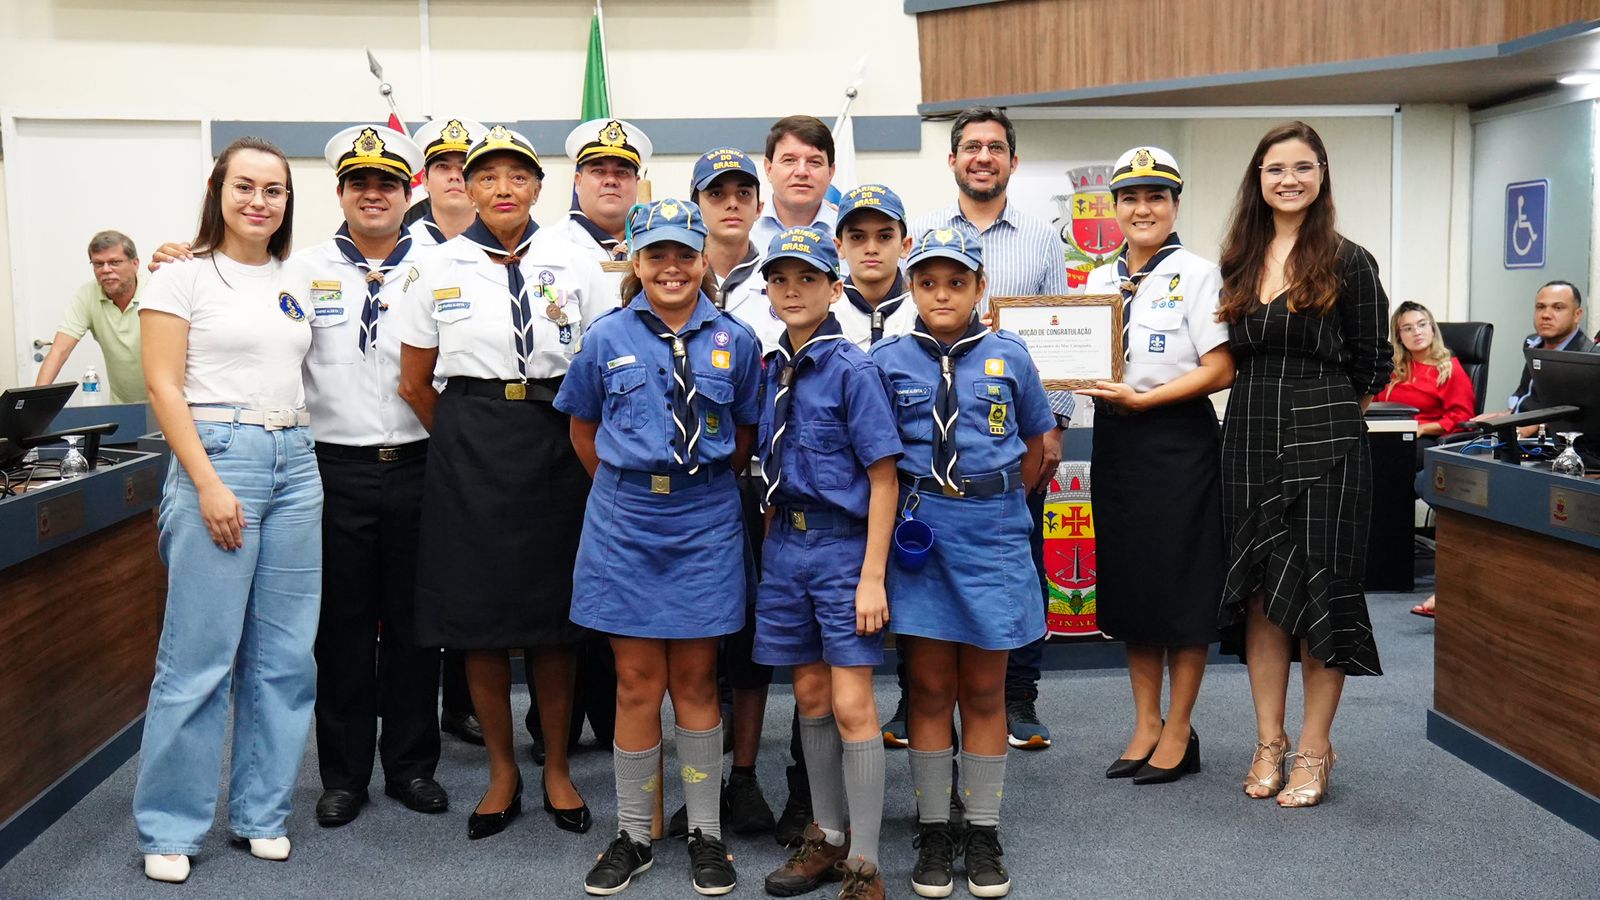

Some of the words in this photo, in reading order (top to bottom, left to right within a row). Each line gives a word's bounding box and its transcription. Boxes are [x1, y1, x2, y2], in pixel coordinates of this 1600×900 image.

[707, 149, 744, 160] MARINHA
[713, 161, 741, 170] BRASIL
[849, 186, 886, 199] MARINHA
[854, 198, 881, 208] BRASIL
[780, 228, 821, 243] MARINHA
[791, 235, 805, 243] DO
[781, 243, 811, 254] BRASIL
[1018, 328, 1037, 337] MOÇÃO
[1038, 328, 1045, 336] DE
[1046, 327, 1092, 336] CONGRATULAÇÃO
